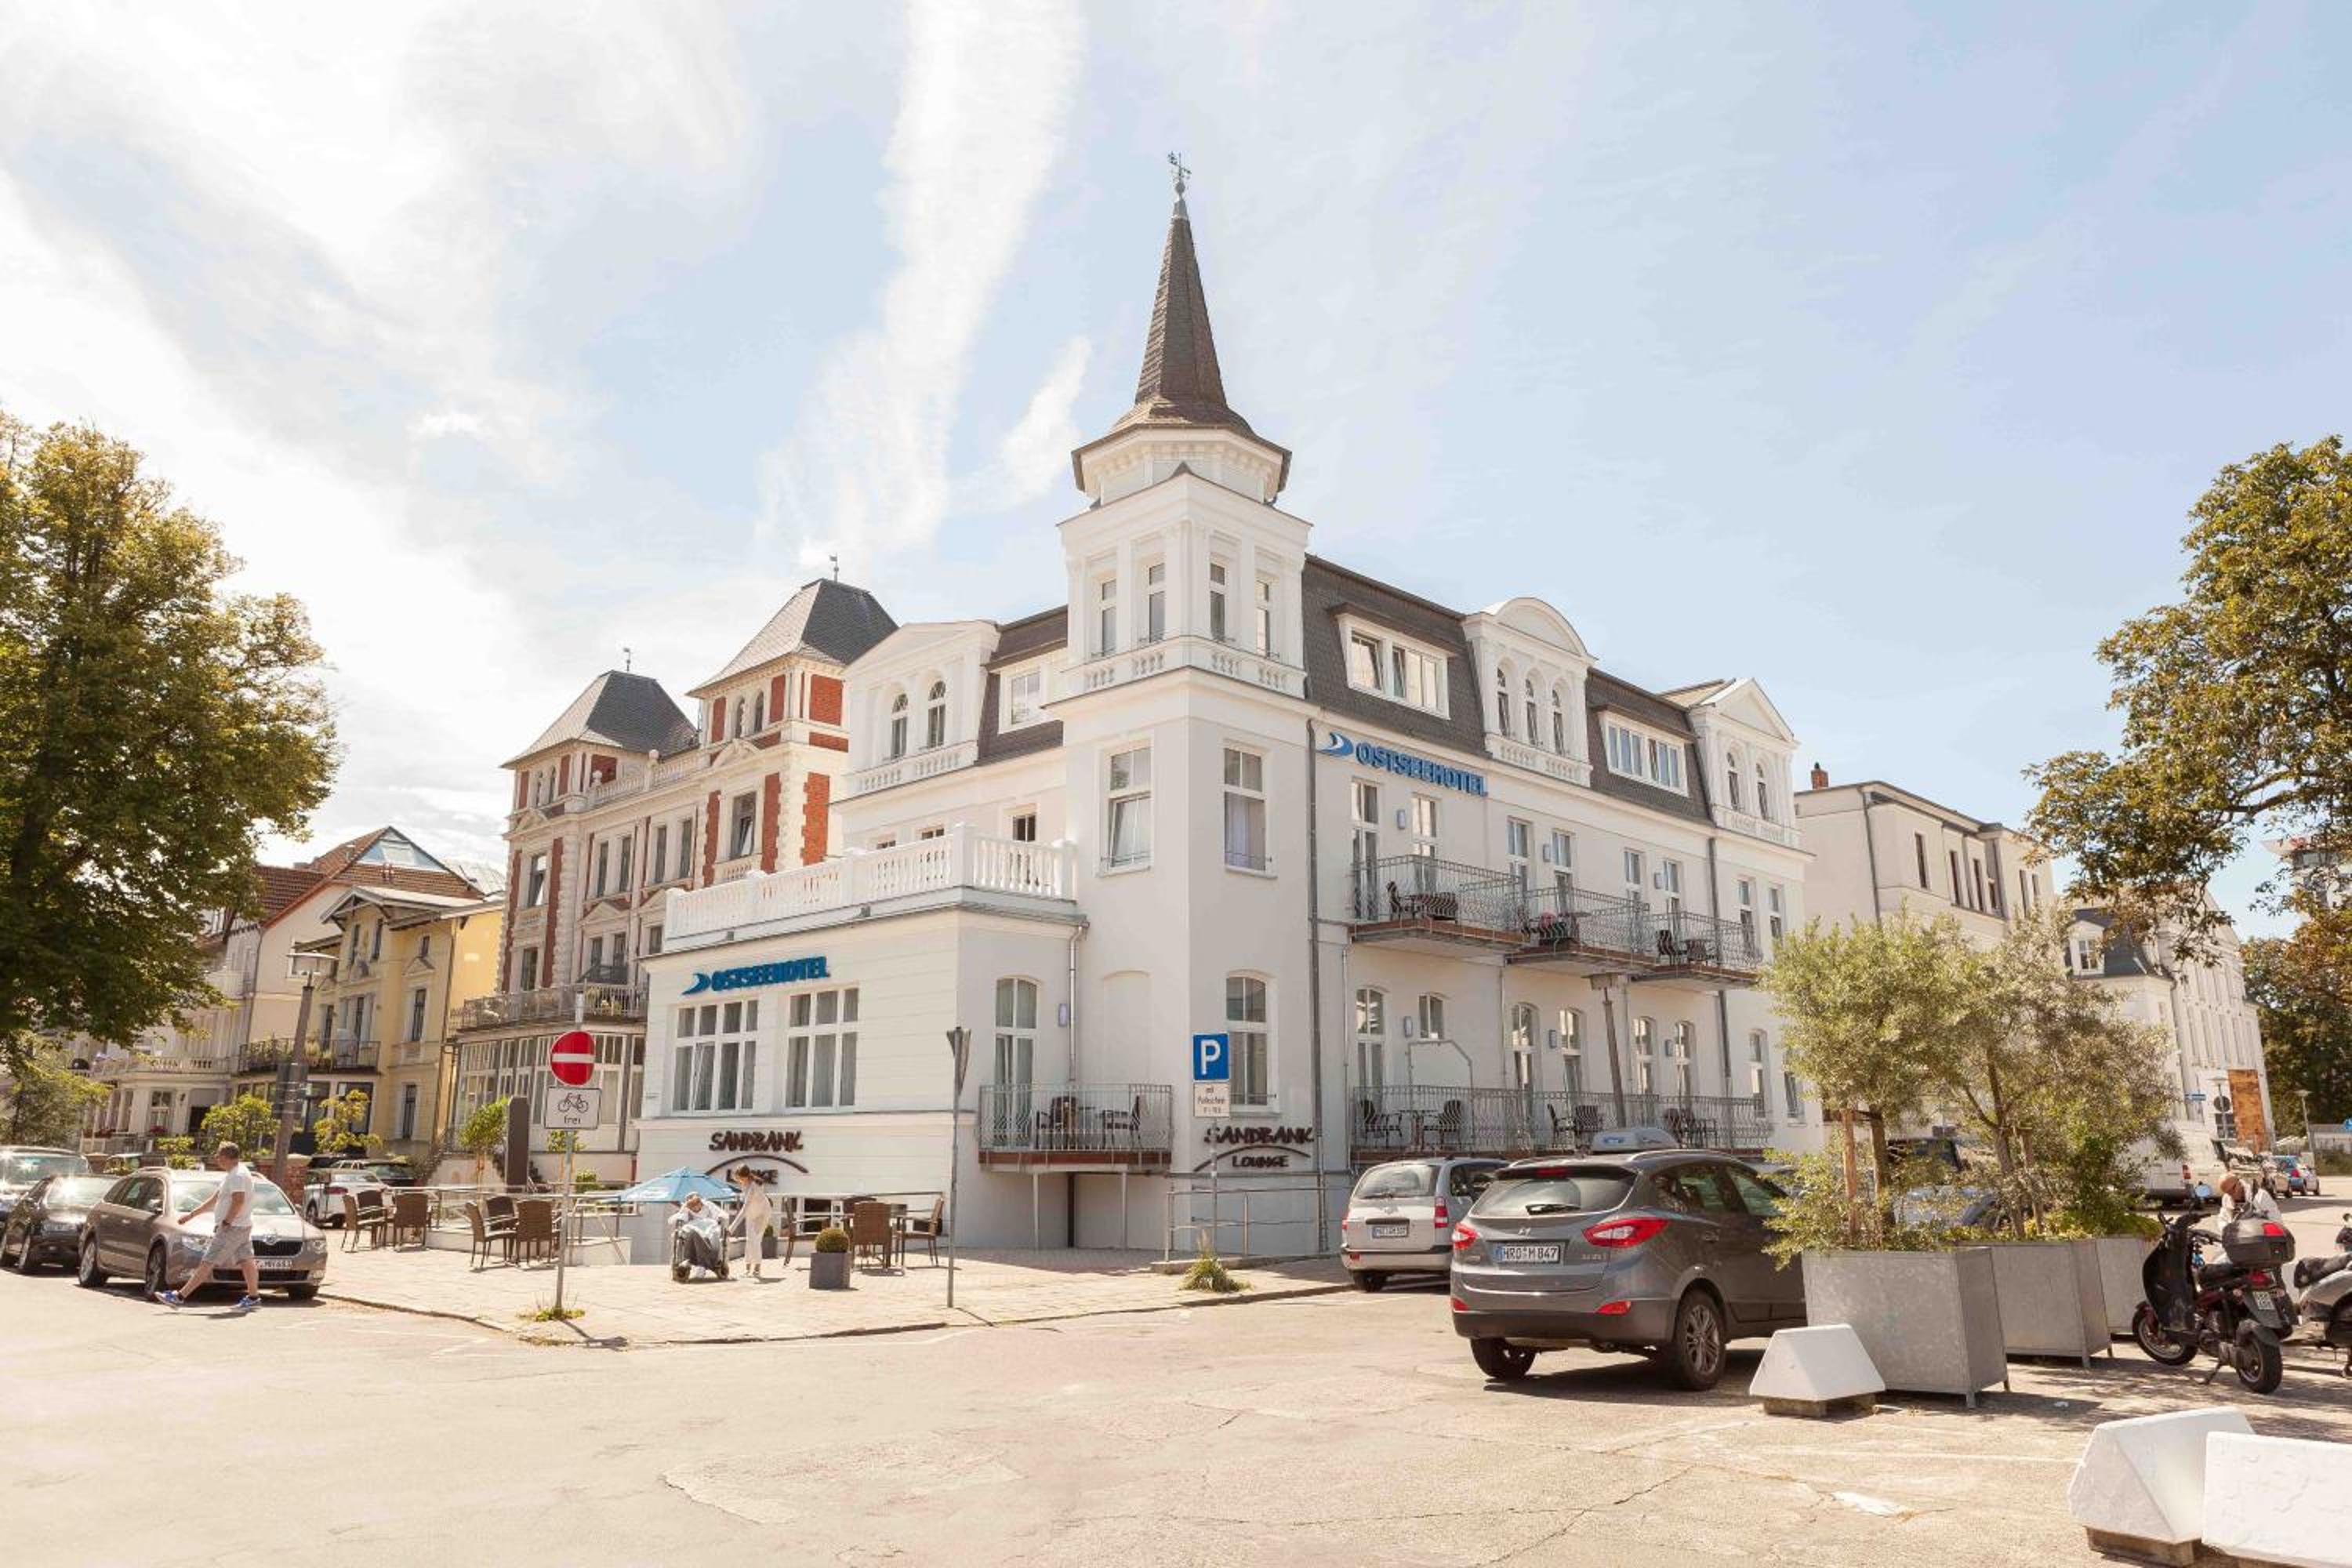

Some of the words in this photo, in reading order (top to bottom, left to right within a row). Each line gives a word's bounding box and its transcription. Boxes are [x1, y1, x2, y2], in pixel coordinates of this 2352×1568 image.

[1356, 742, 1489, 797] OSTSEEHOTEL
[712, 956, 830, 991] OSTSEEHOTEL
[1201, 1040, 1221, 1075] P
[564, 1115, 581, 1124] frei
[709, 1130, 804, 1152] SANDBANK
[1203, 1125, 1315, 1144] SANDBANK
[1232, 1155, 1290, 1167] LOUNGE
